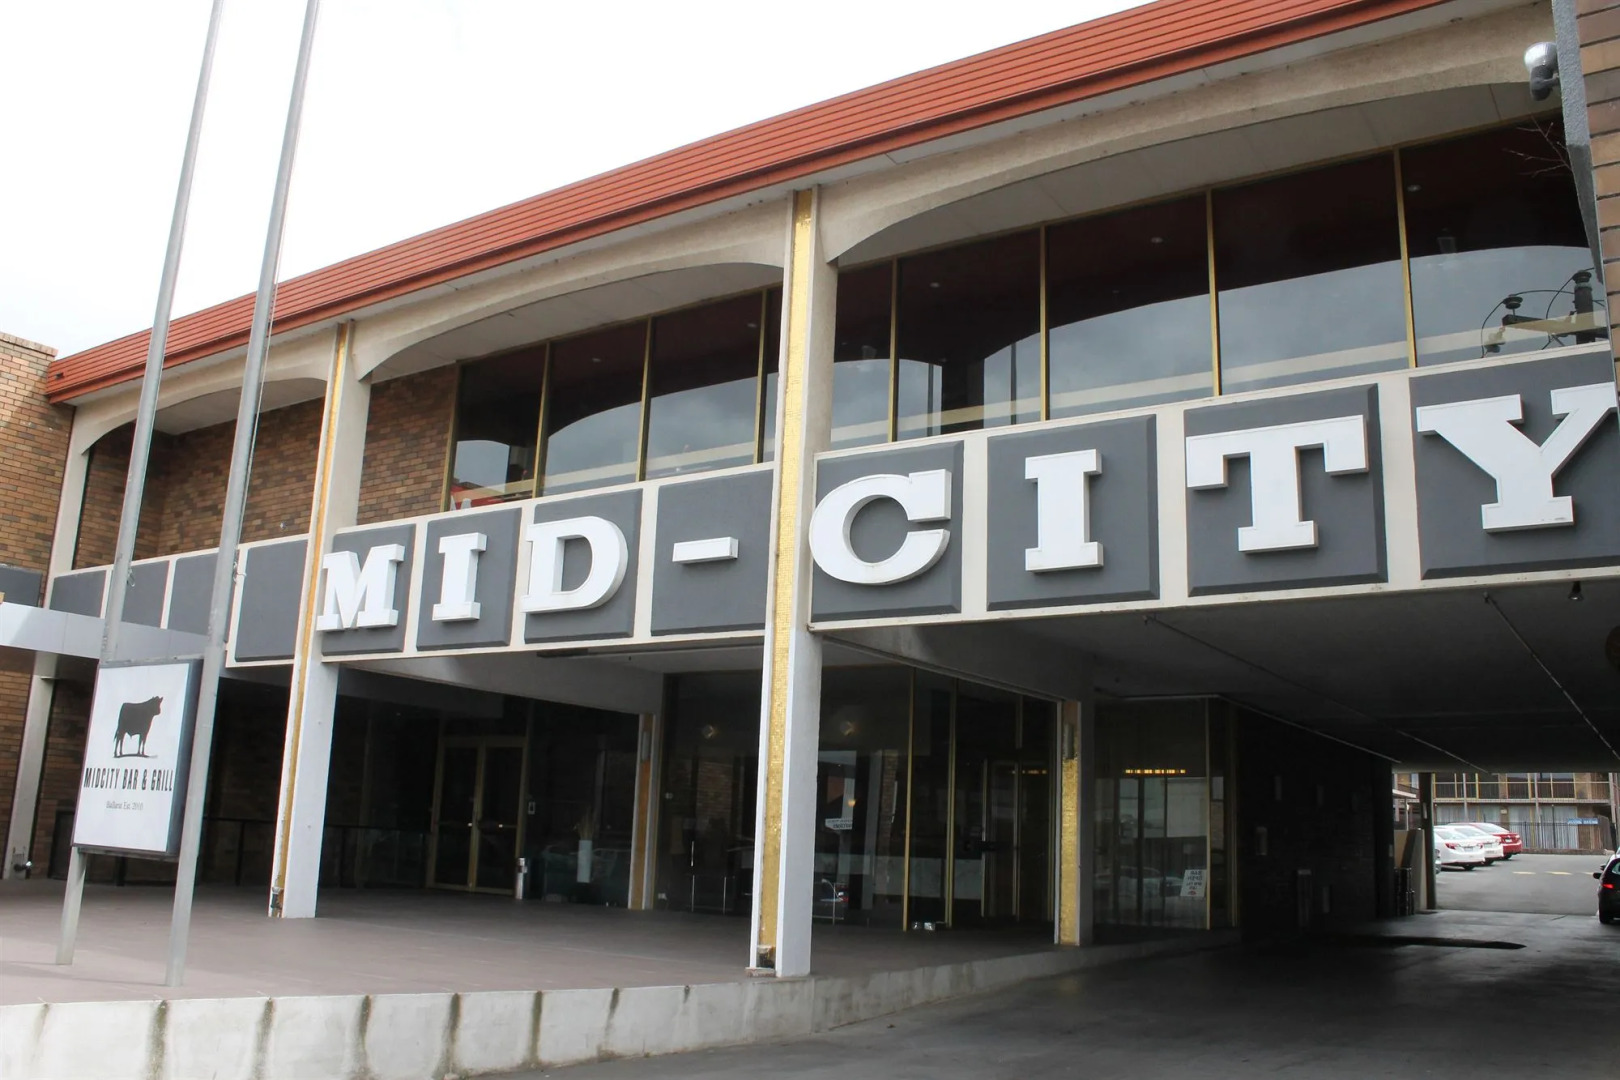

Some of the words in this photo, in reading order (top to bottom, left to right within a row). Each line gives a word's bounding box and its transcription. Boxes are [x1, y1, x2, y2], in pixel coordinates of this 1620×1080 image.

[83, 767, 120, 789] MIDCITY
[122, 768, 139, 790] BAR
[142, 768, 148, 791] &
[151, 769, 174, 792] GRILL
